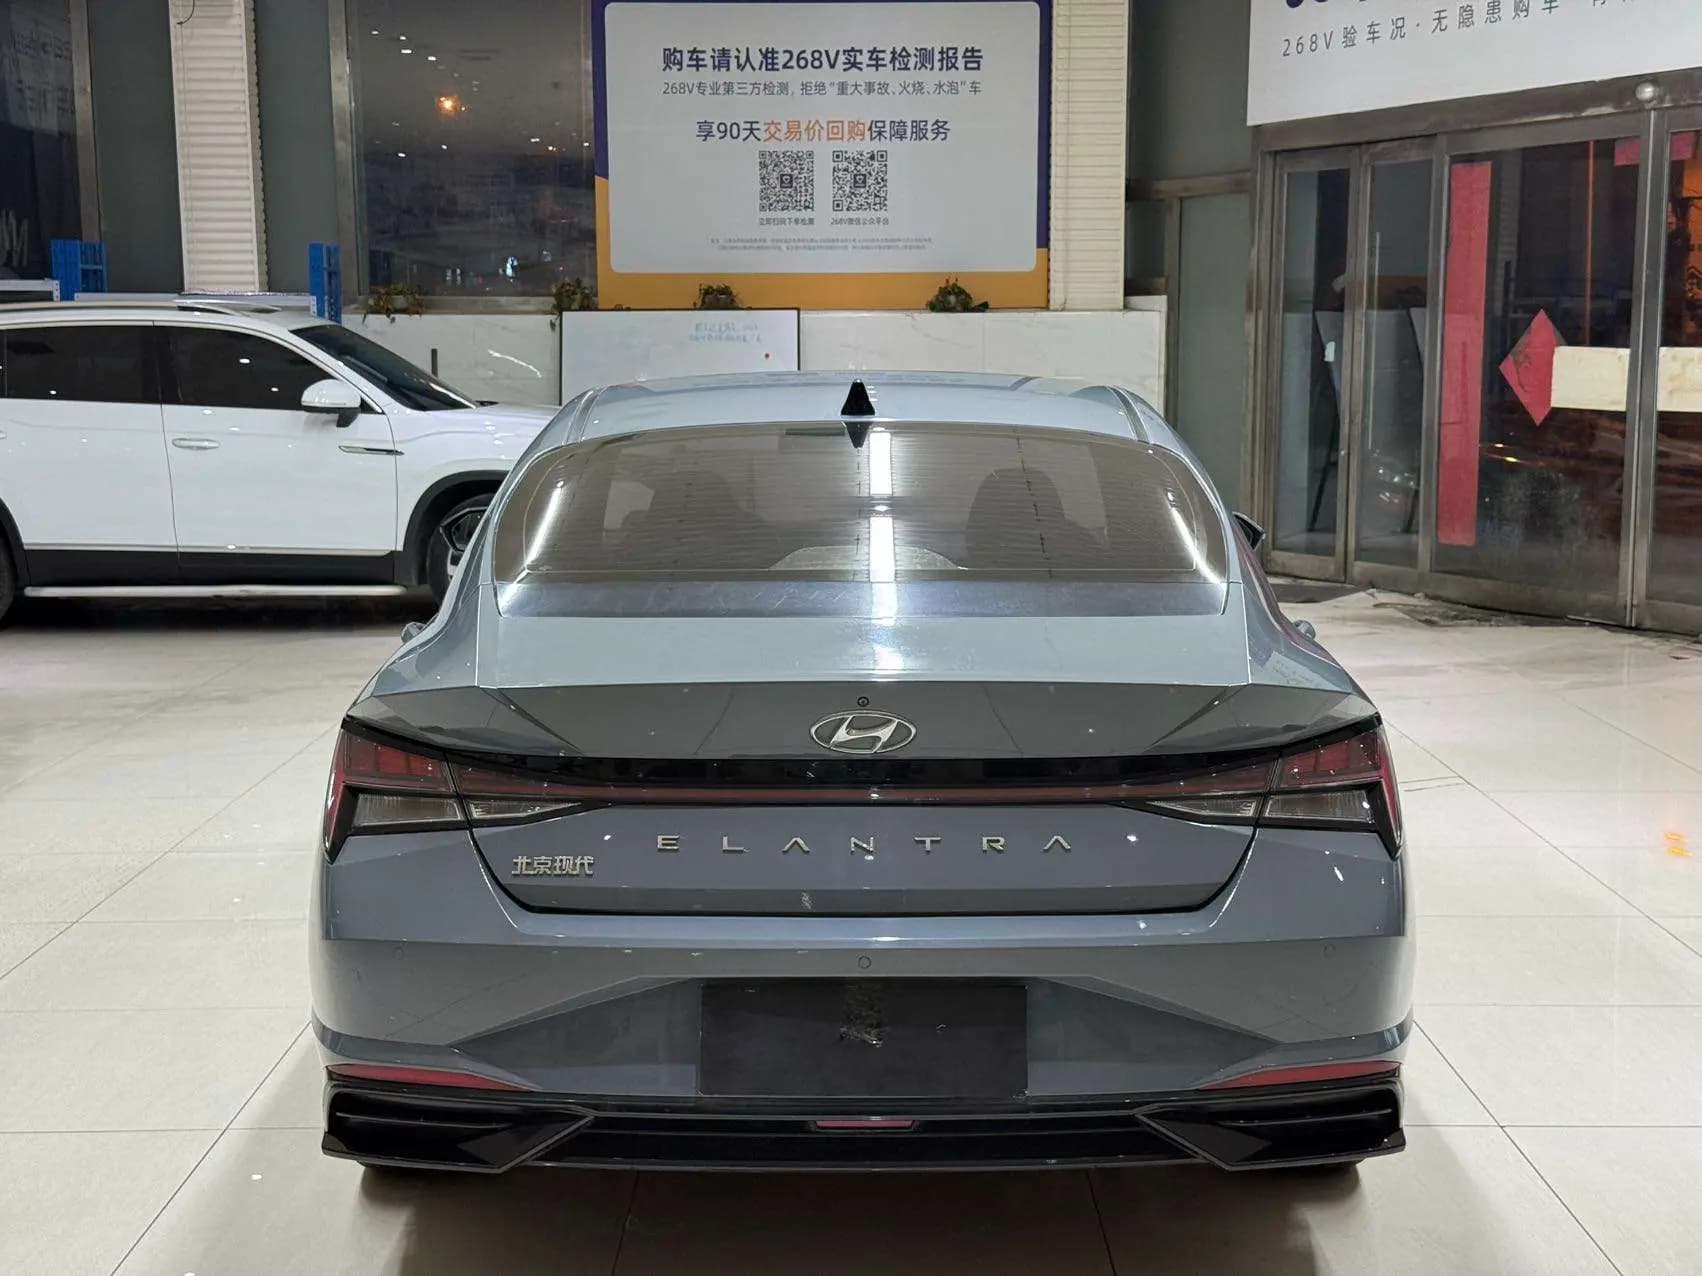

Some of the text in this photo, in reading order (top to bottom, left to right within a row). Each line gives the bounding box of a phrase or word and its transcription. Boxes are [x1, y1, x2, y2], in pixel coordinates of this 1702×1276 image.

[662, 47, 984, 72] 购车请认准268V实车检测报告
[696, 119, 951, 142] 享90天交易价回购保障服务
[657, 835, 1072, 853] ELANTRA
[512, 855, 594, 876] 北京现代
